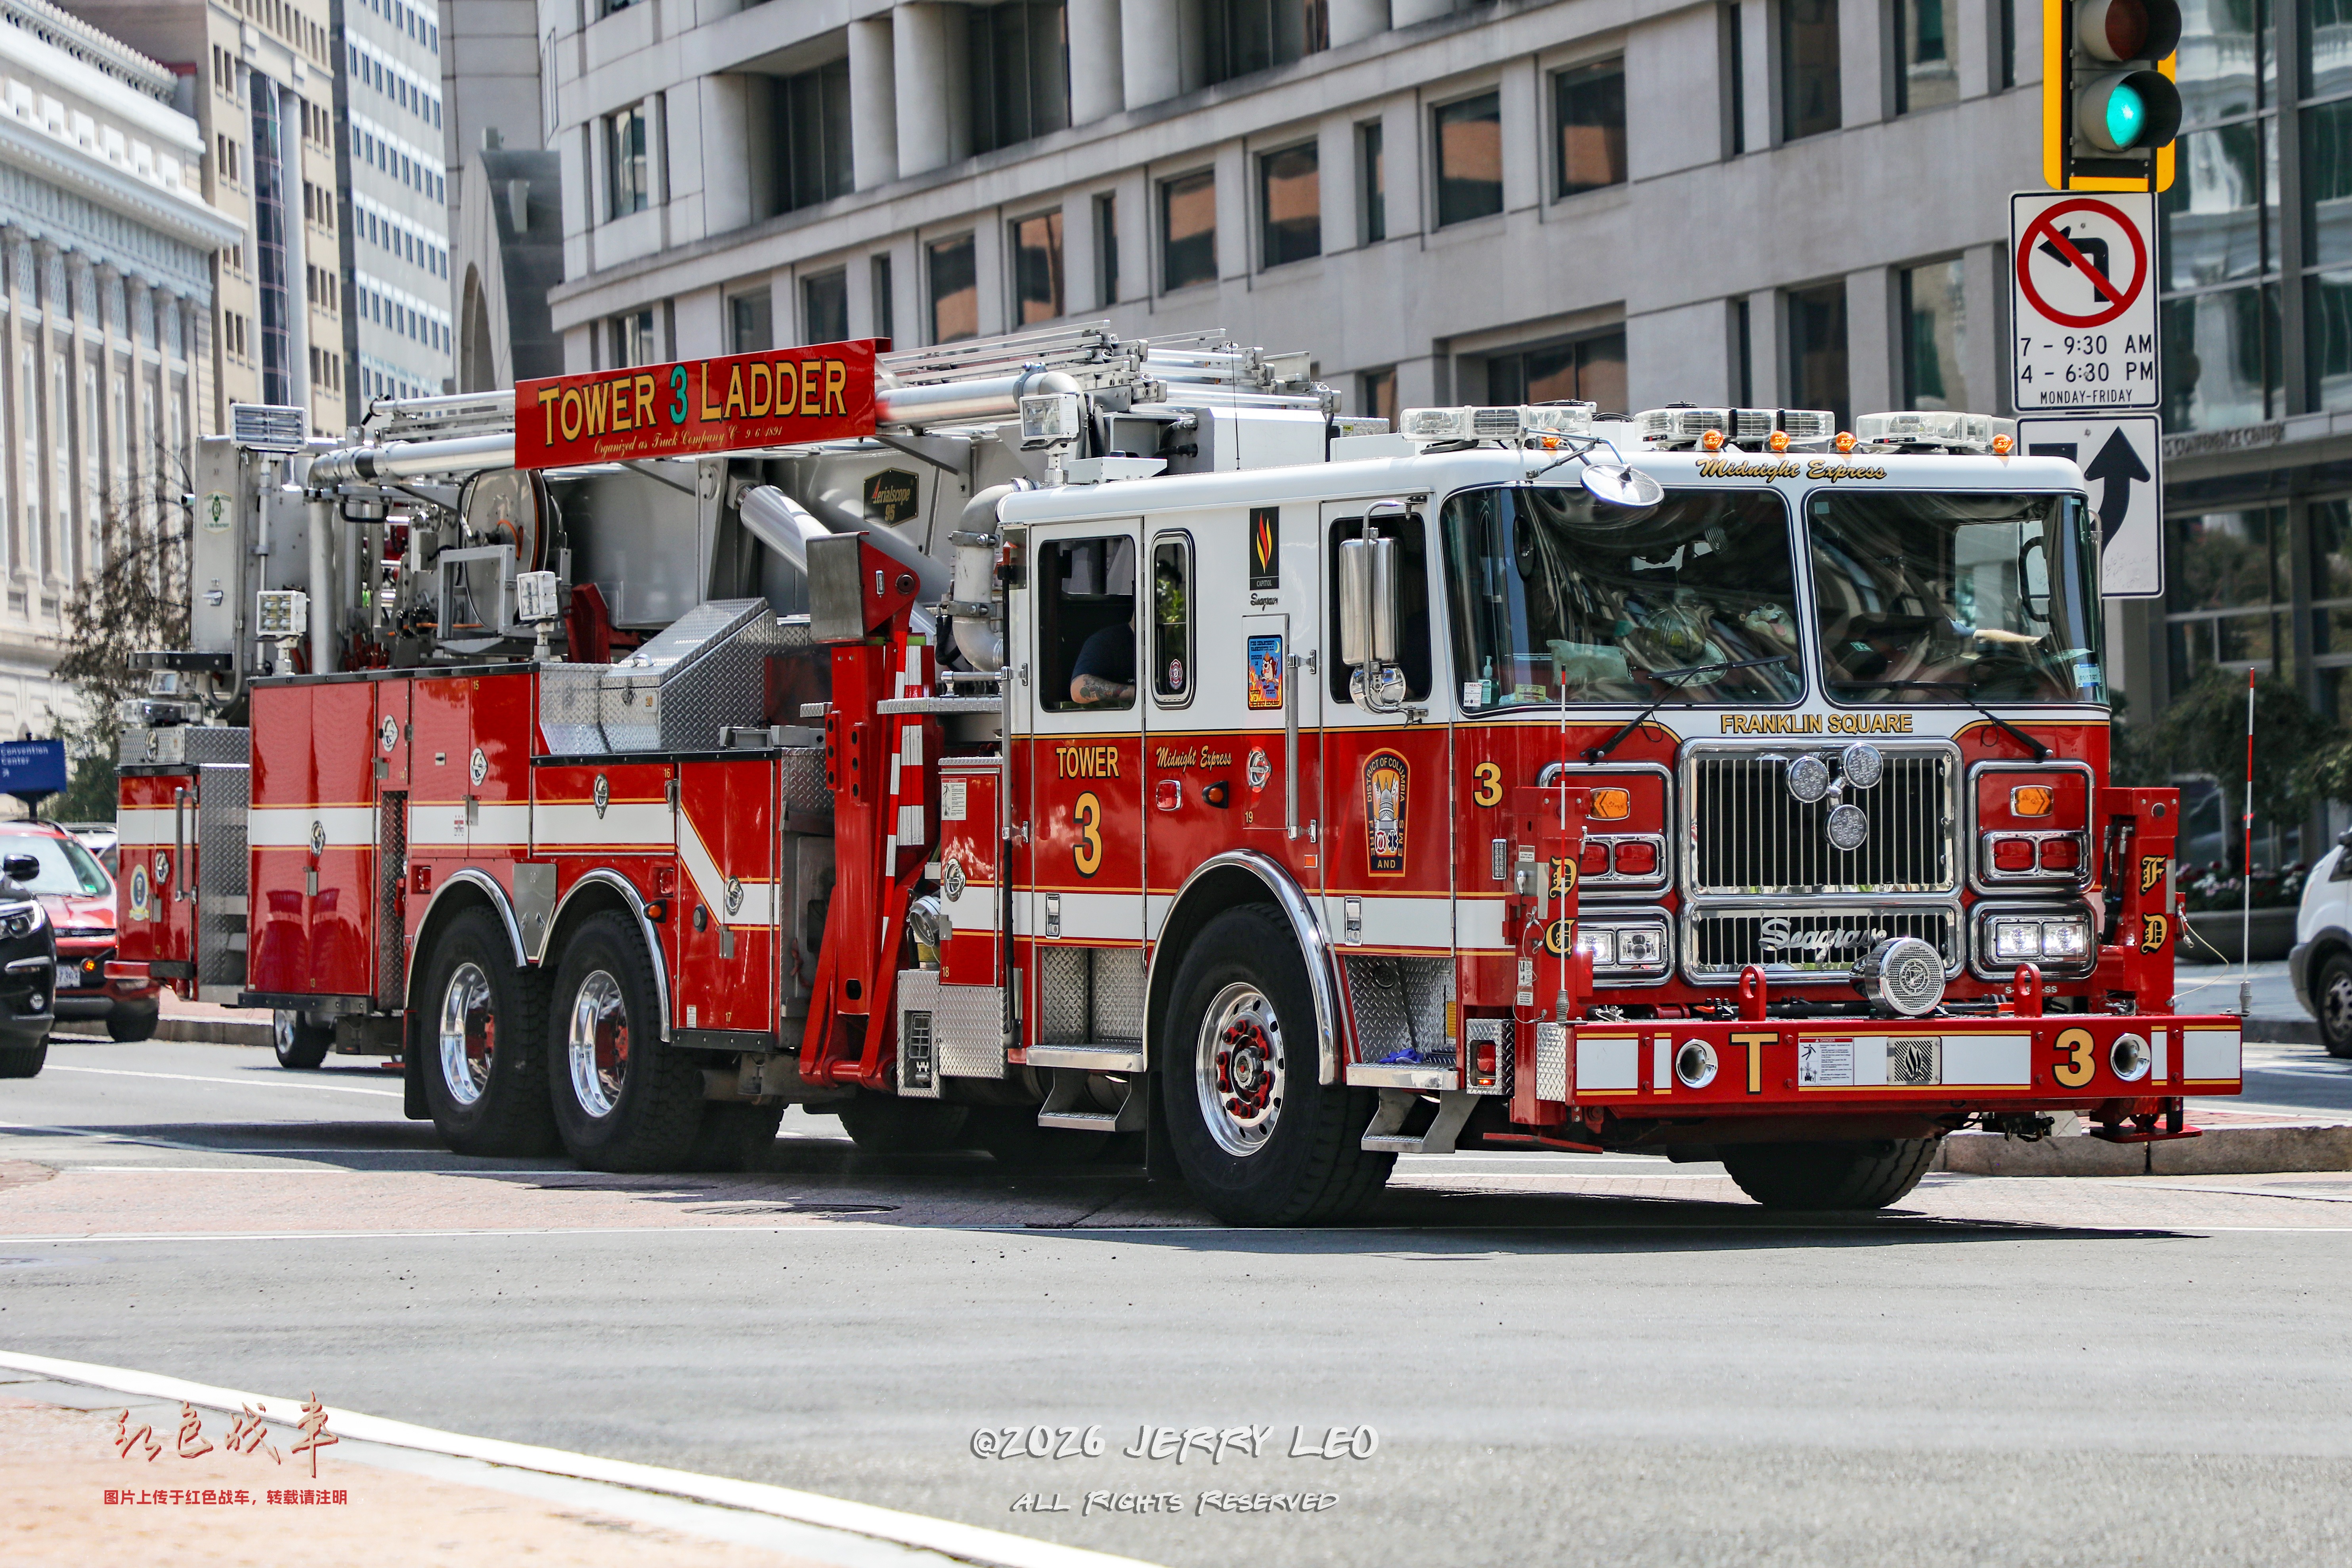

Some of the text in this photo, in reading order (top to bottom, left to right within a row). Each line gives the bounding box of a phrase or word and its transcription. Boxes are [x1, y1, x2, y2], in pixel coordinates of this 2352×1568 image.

[2021, 338, 2031, 356] 7
[2064, 335, 2107, 355] 9:30
[2125, 334, 2151, 354] AM
[2021, 365, 2032, 383] 4
[2066, 363, 2109, 382] 6:30
[2126, 361, 2153, 381] PM
[538, 358, 847, 447] TOWER 3 LADDER
[2041, 389, 2132, 404] MONDAY-FRIDAY
[595, 436, 636, 459] Organized
[652, 432, 677, 448] Truck
[681, 429, 725, 449] Company
[1696, 458, 1887, 483] Midnight Express
[872, 478, 910, 506] Aerialscope
[885, 504, 895, 521] 95
[473, 680, 479, 690] 15
[1721, 713, 1913, 734] FRANKLIN SQUARE
[0, 744, 48, 756] Convention
[1, 755, 30, 766] Center
[1156, 745, 1232, 773] Midnight Express
[664, 768, 671, 778] 16
[1056, 746, 1120, 779] TOWER
[1366, 757, 1406, 803] DISTRICT OF COLUMBIA
[1473, 761, 1503, 808] 3
[1245, 811, 1253, 823] 19
[1073, 791, 1103, 878] 3
[1377, 860, 1396, 868] AND
[1758, 918, 1887, 964] Seagrave
[942, 966, 949, 977] 18
[725, 1012, 732, 1022] 17
[1729, 1032, 1780, 1095] T
[2052, 1028, 2096, 1089] 3
